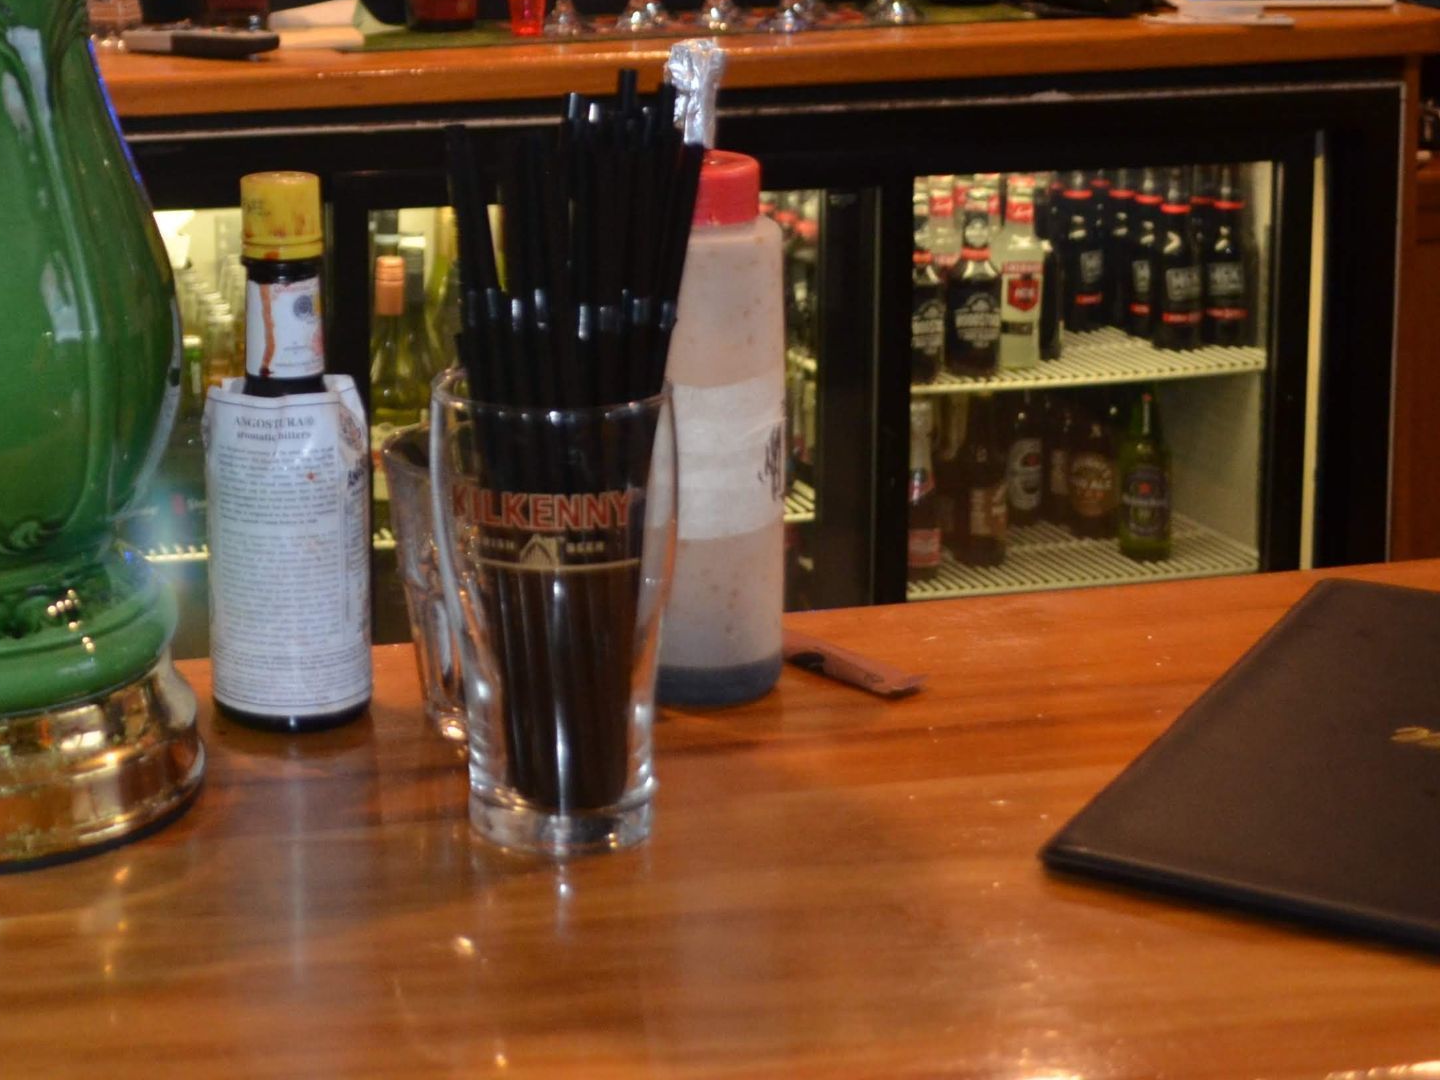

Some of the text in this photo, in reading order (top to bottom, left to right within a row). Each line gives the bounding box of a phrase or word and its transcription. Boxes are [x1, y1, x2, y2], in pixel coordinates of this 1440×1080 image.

[236, 430, 312, 443] aromatic bitters
[453, 483, 634, 532] KILKENNY
